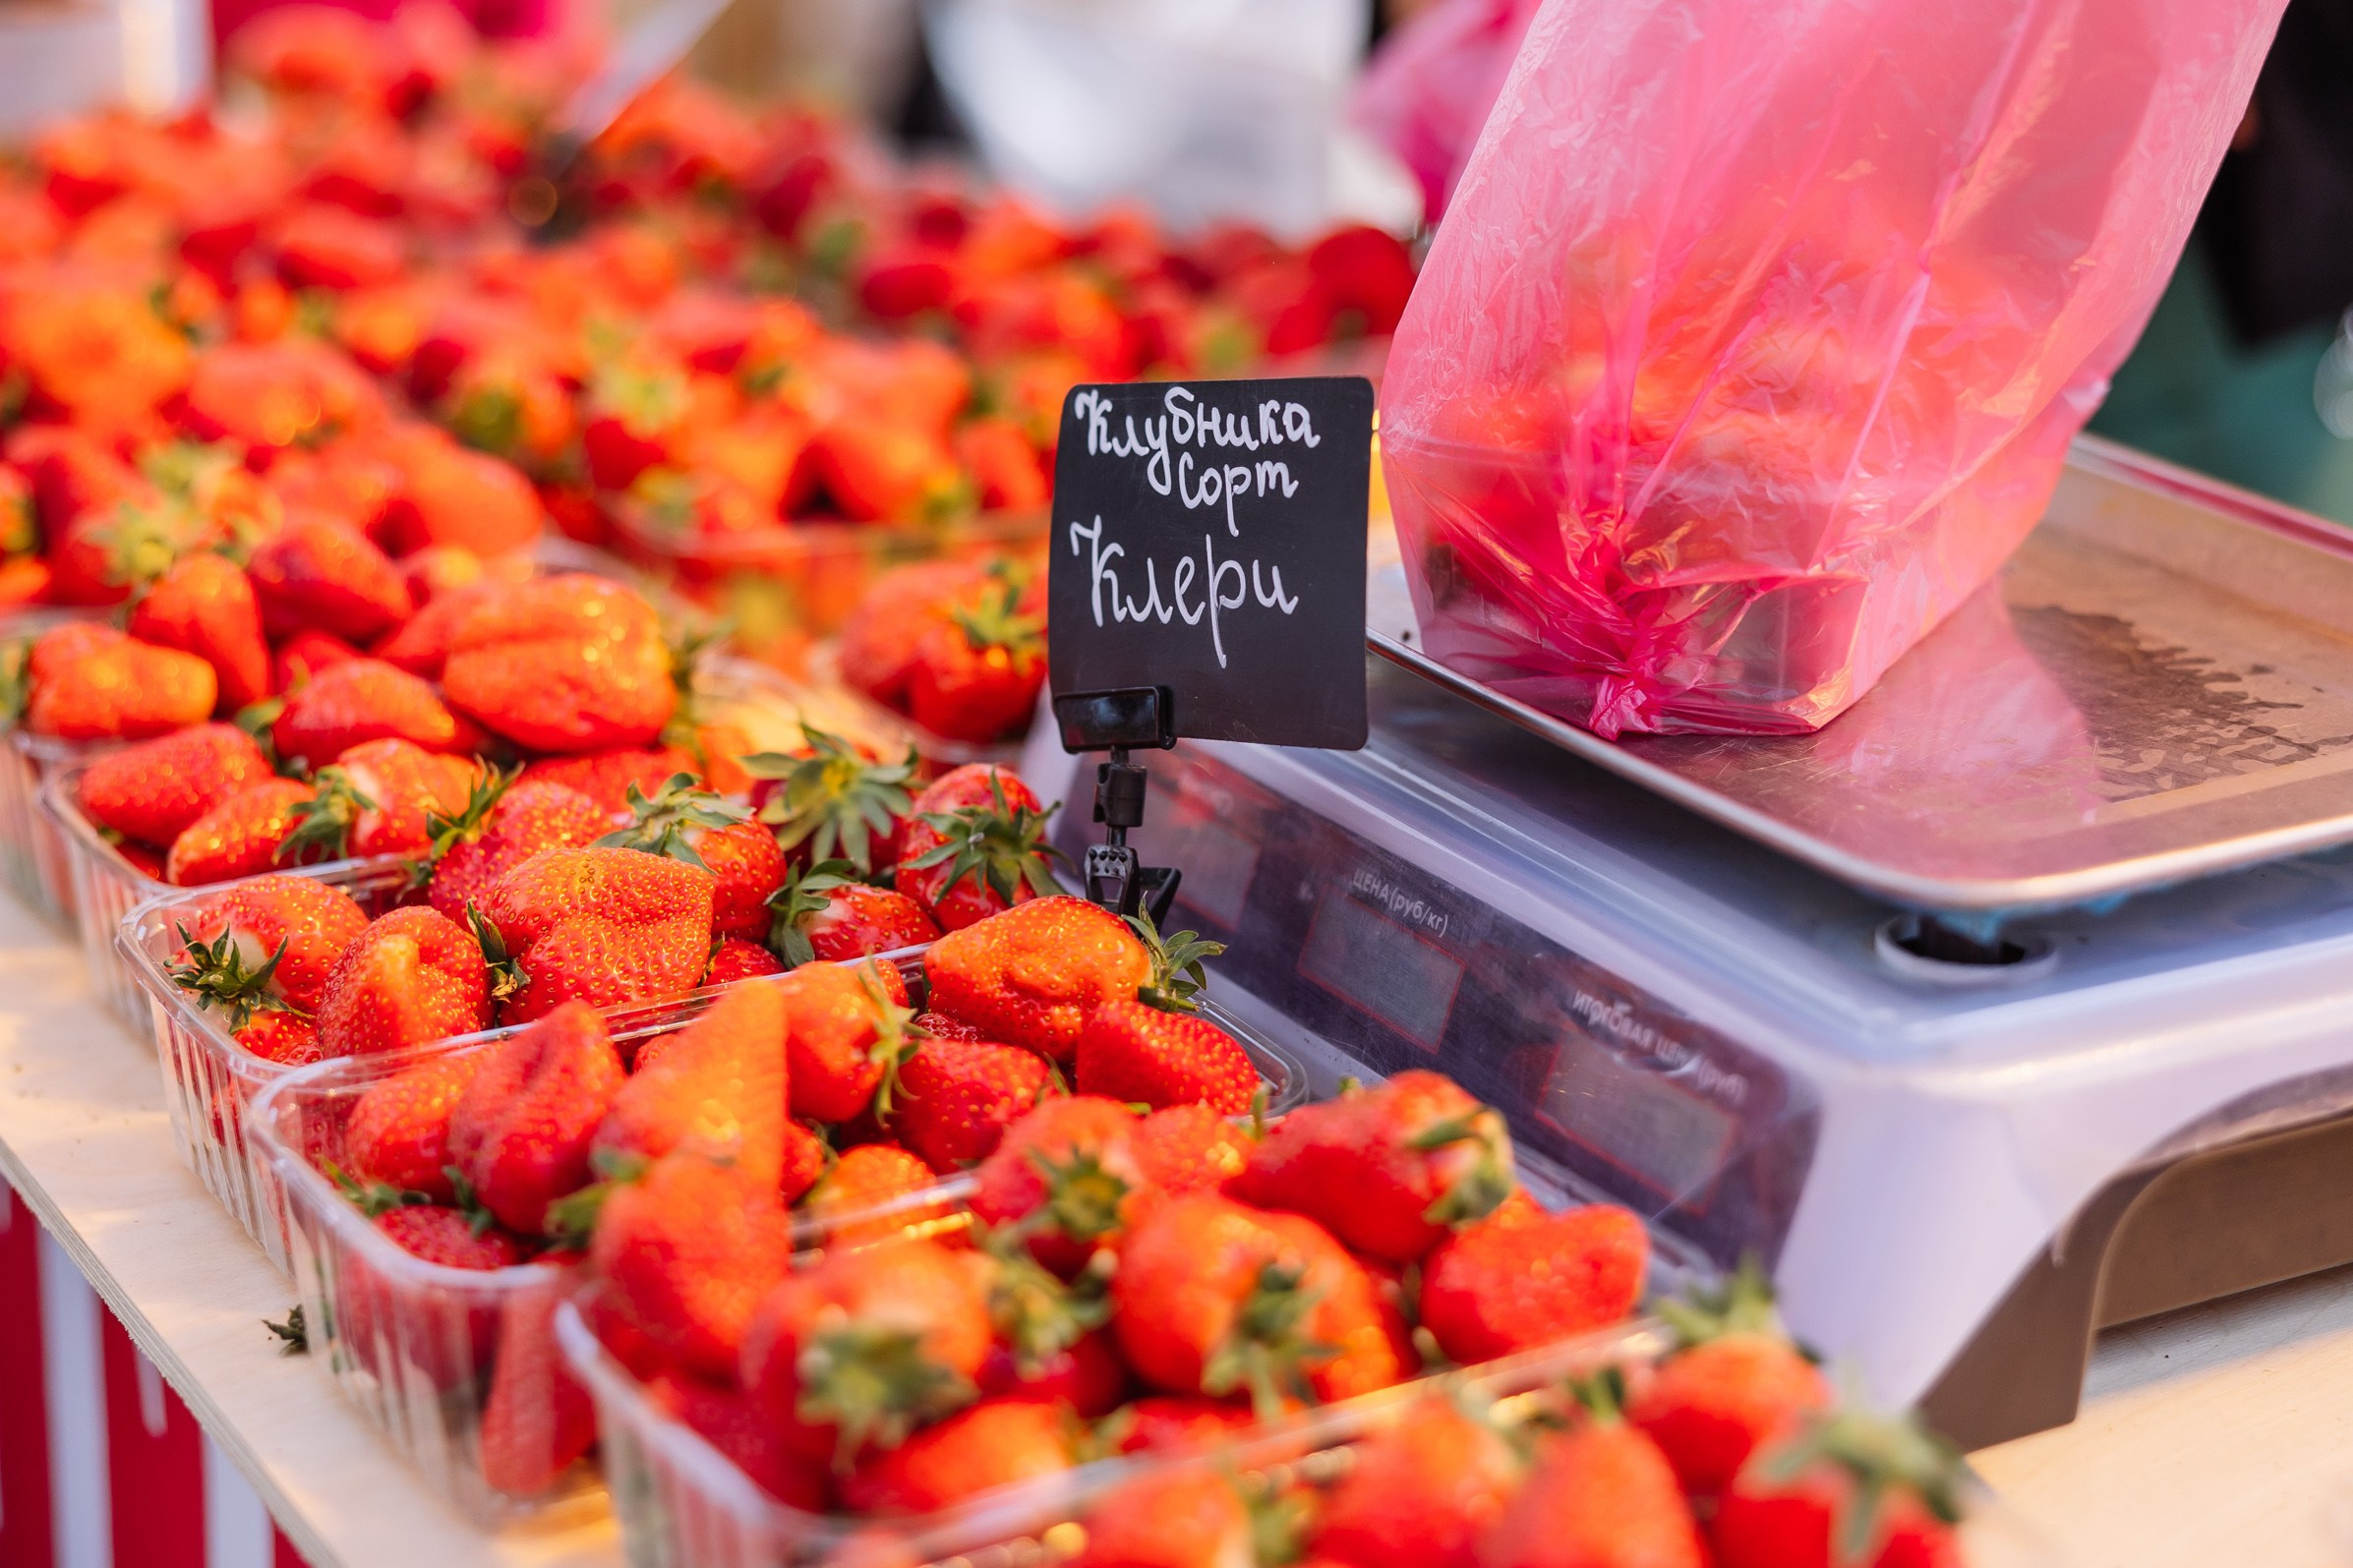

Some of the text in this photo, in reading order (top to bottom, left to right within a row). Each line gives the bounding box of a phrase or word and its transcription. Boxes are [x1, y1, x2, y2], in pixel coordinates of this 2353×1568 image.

[1075, 386, 1321, 495] Клубника
[1070, 514, 1299, 668] Клери
[1352, 868, 1448, 938] ЦЕНА(руб/кг)
